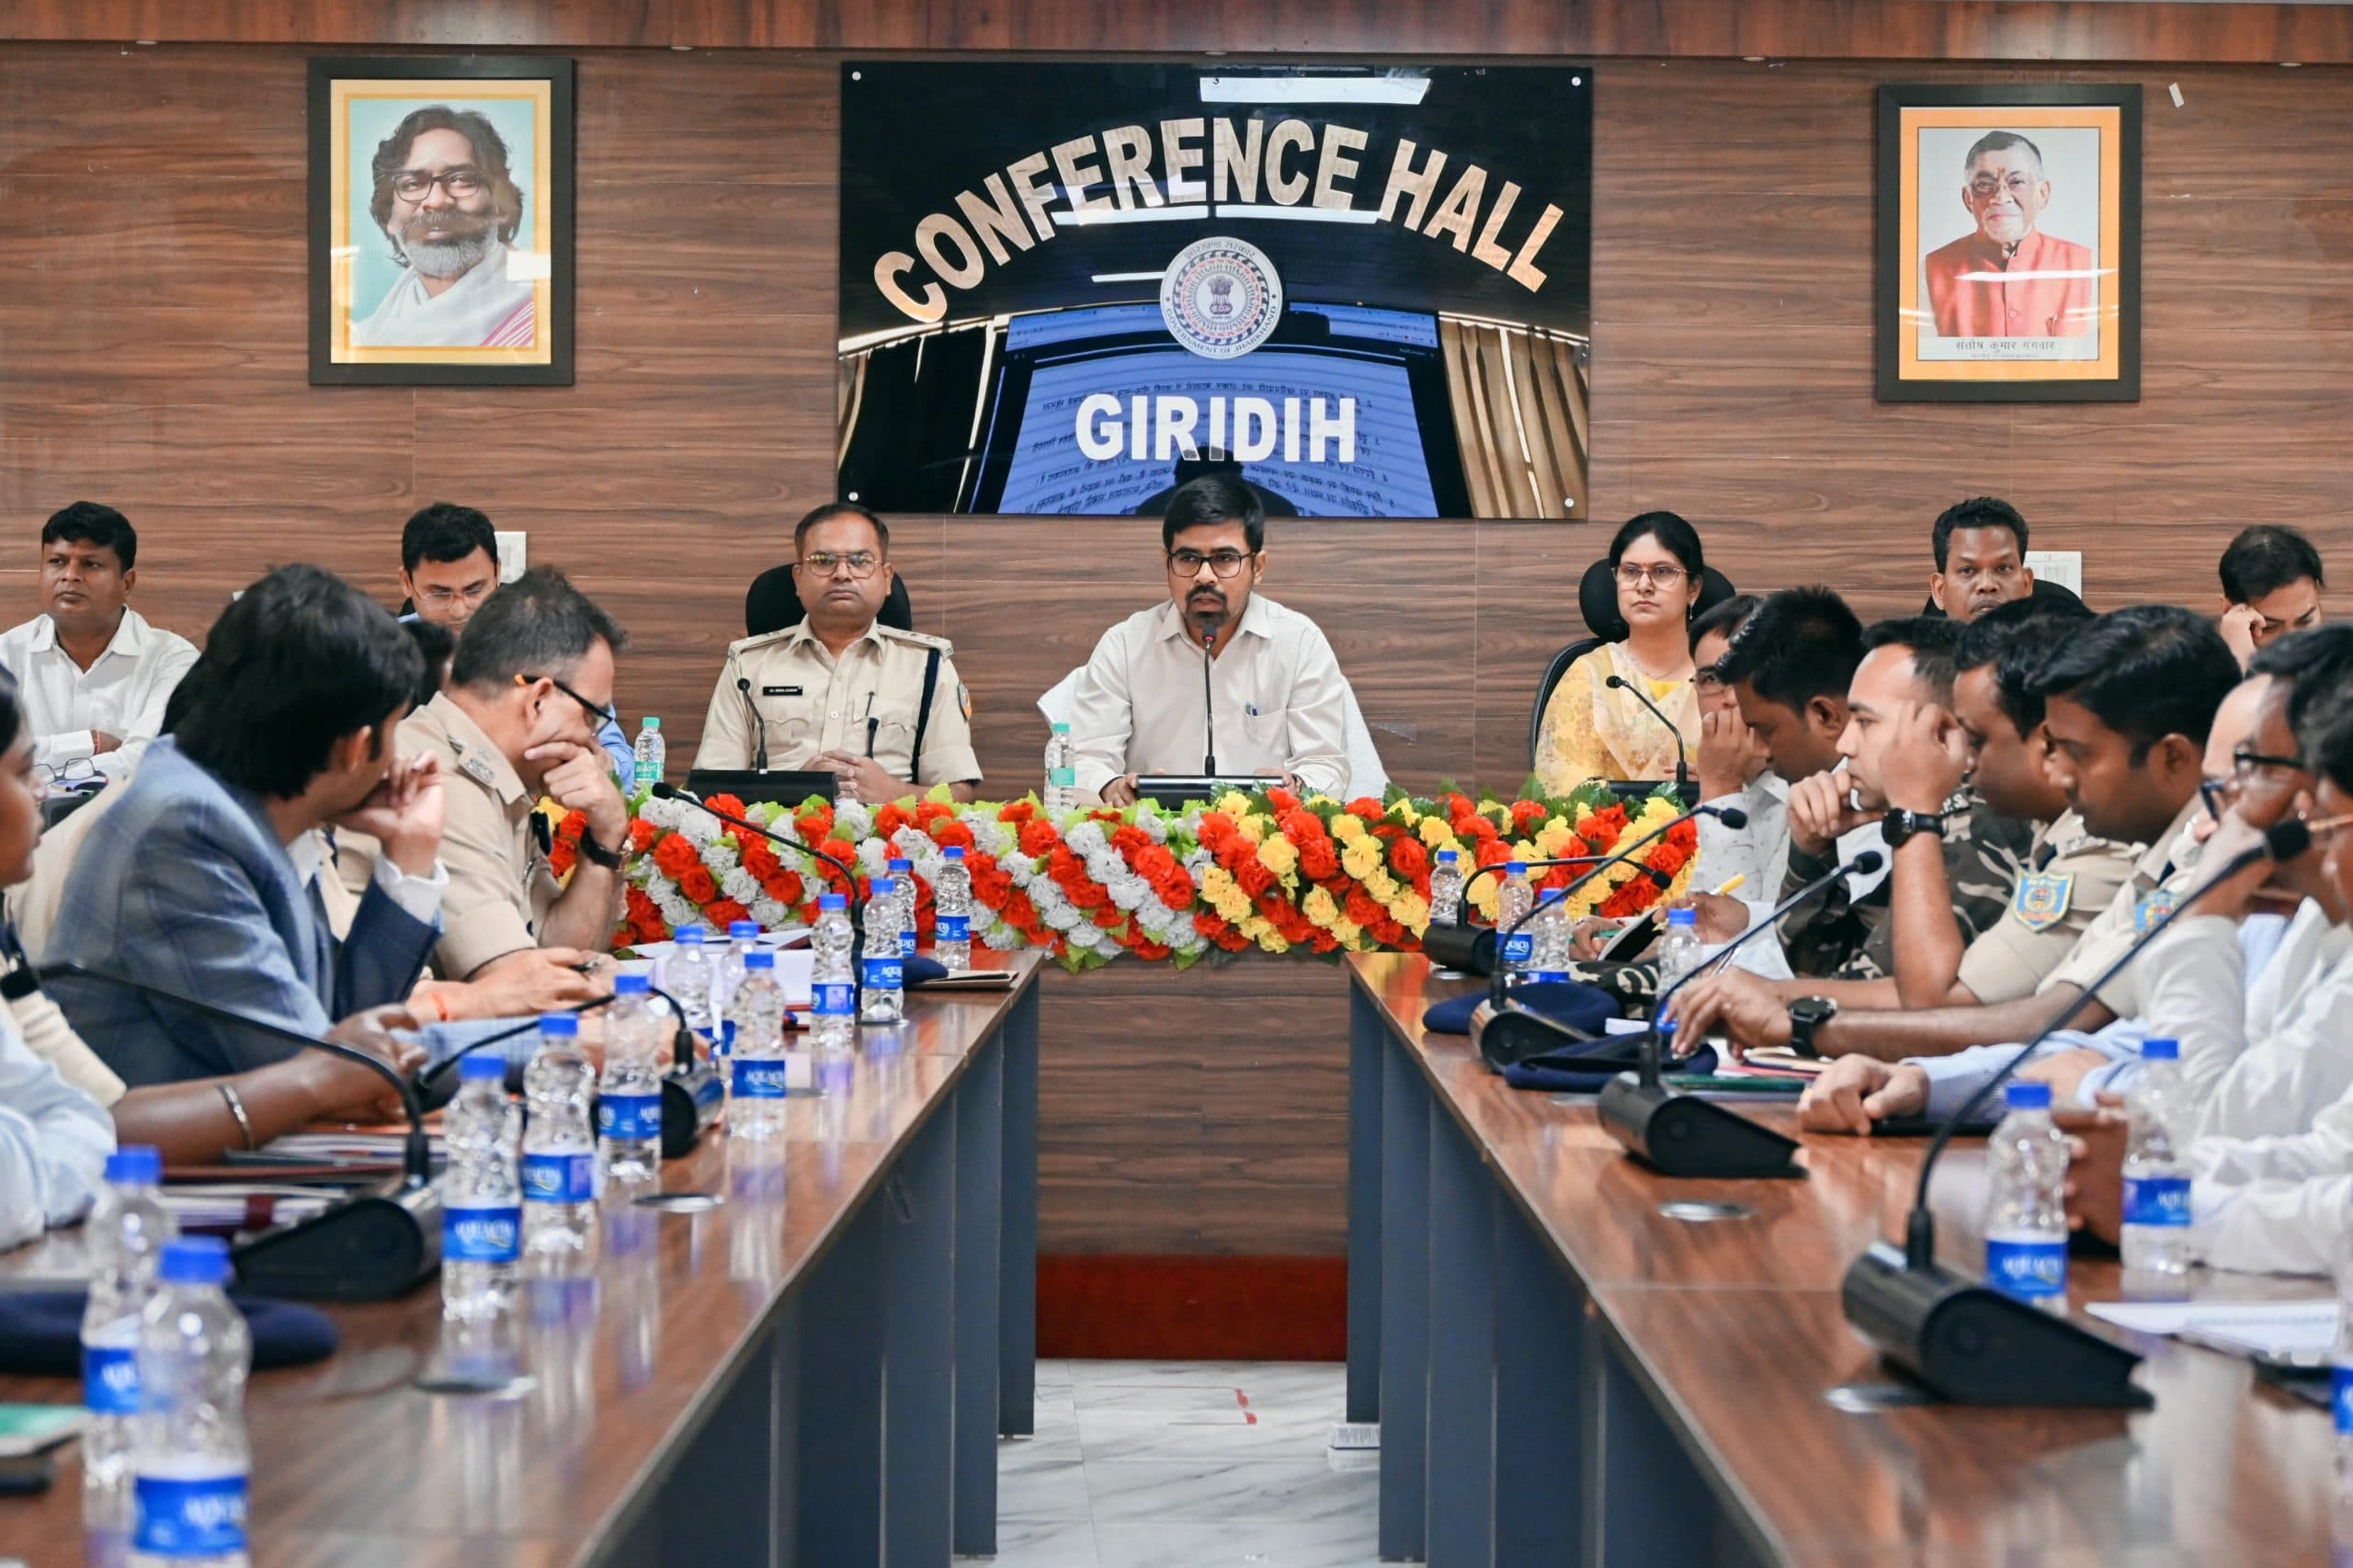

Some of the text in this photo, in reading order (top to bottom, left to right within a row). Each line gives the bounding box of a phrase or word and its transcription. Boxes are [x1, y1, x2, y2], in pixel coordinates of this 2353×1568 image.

[874, 117, 1564, 324] CONFERENCE HALL
[1165, 308, 1217, 354] GOVERNMENT
[1234, 305, 1277, 353] JHARKHAND
[1074, 393, 1356, 463] GIRIDIH
